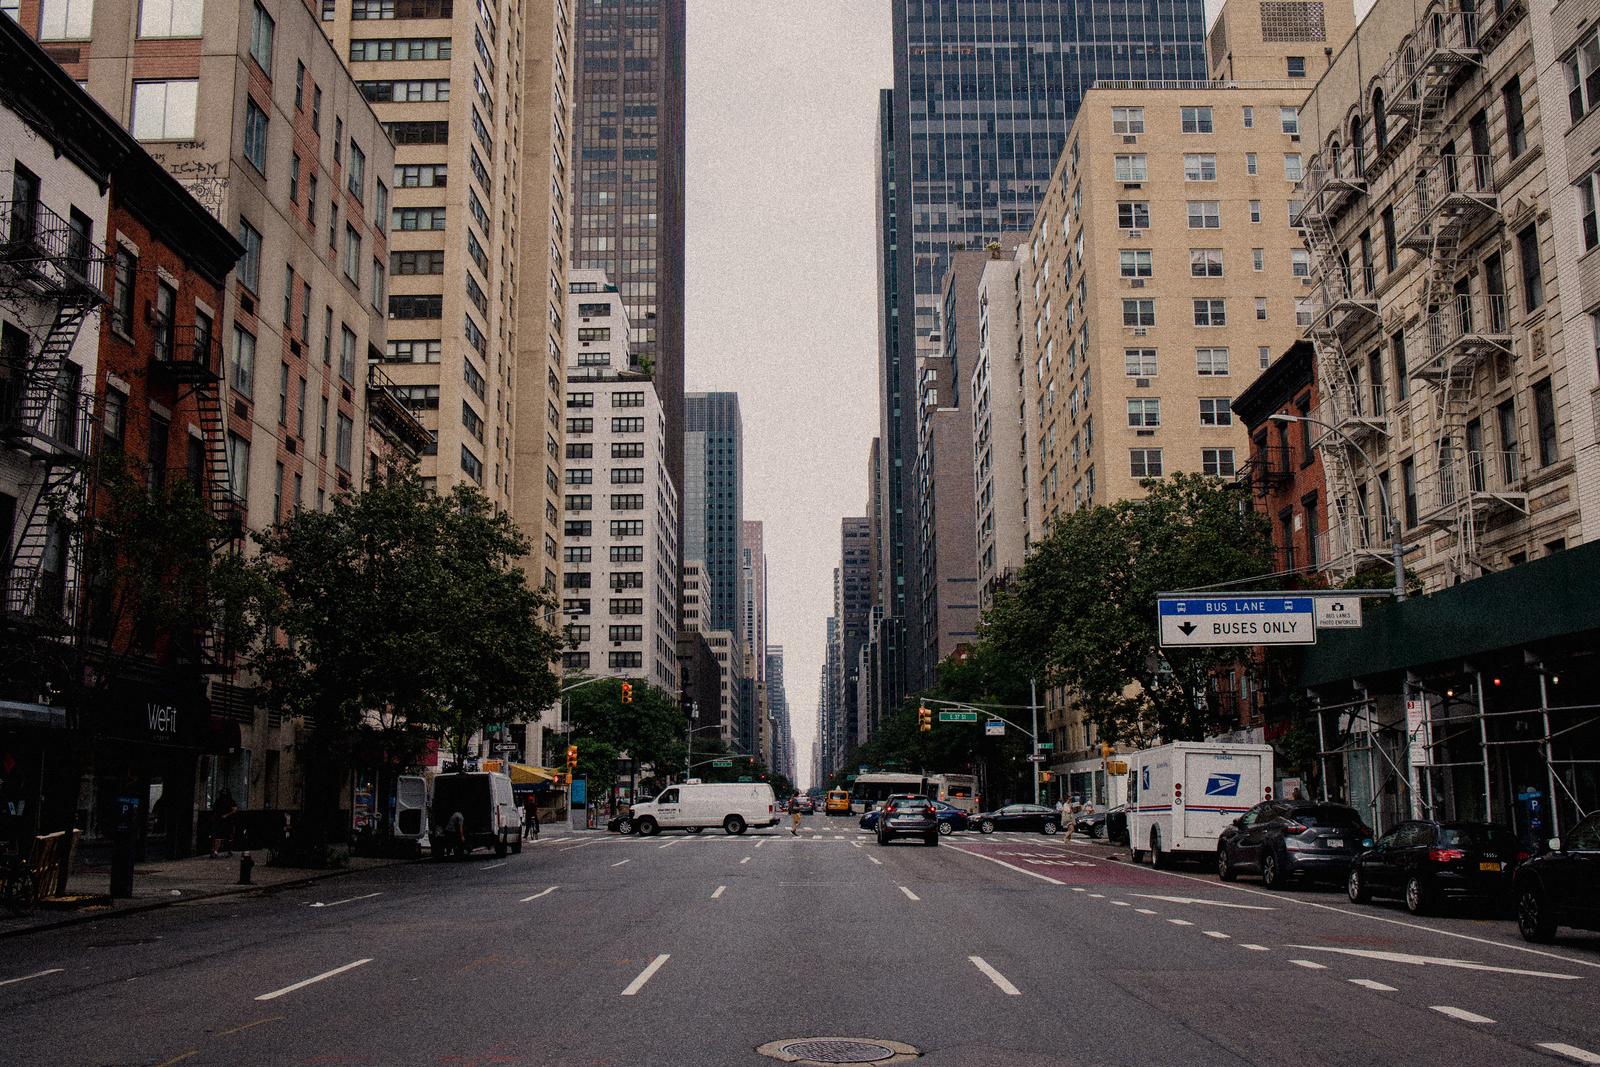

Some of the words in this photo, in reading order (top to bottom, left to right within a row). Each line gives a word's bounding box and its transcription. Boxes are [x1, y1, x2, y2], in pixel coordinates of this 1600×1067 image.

[1206, 602, 1228, 612] BUS
[1235, 602, 1266, 611] LANE
[1213, 622, 1258, 635] BUSES
[1263, 621, 1298, 634] ONLY
[147, 703, 177, 733] WeFit
[1531, 800, 1538, 811] P
